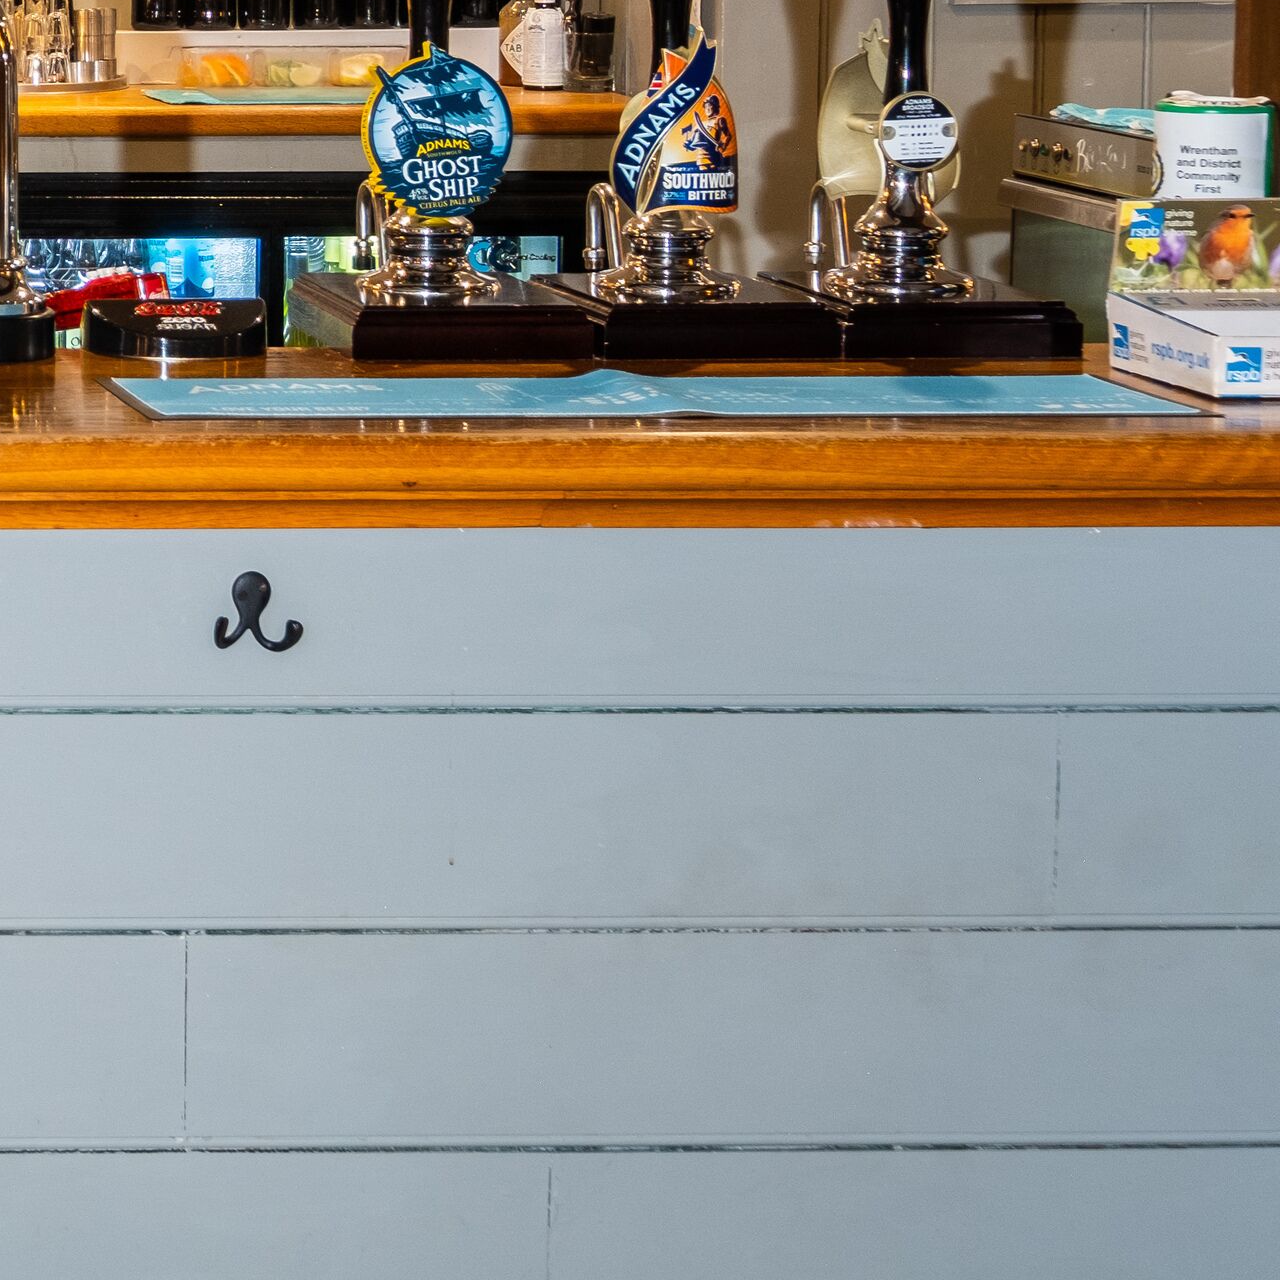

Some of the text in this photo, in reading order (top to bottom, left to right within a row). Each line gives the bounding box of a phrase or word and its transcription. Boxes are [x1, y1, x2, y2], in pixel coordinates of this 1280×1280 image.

[617, 83, 700, 189] ADNAMS.
[1180, 145, 1238, 155] Wrentham
[1177, 158, 1241, 168] and District
[402, 156, 482, 184] GHOST
[662, 171, 735, 189] SOUTHWOLD
[1177, 171, 1240, 182] Community
[429, 176, 479, 201] SHIP
[1195, 184, 1221, 193] First
[688, 190, 726, 200] BITTER
[420, 201, 447, 209] CITRUS
[449, 198, 466, 206] PALE
[1165, 210, 1194, 219] giving
[1130, 228, 1160, 239] rspb
[1151, 342, 1210, 369] rspb.org.uk
[1227, 369, 1259, 382] rspb
